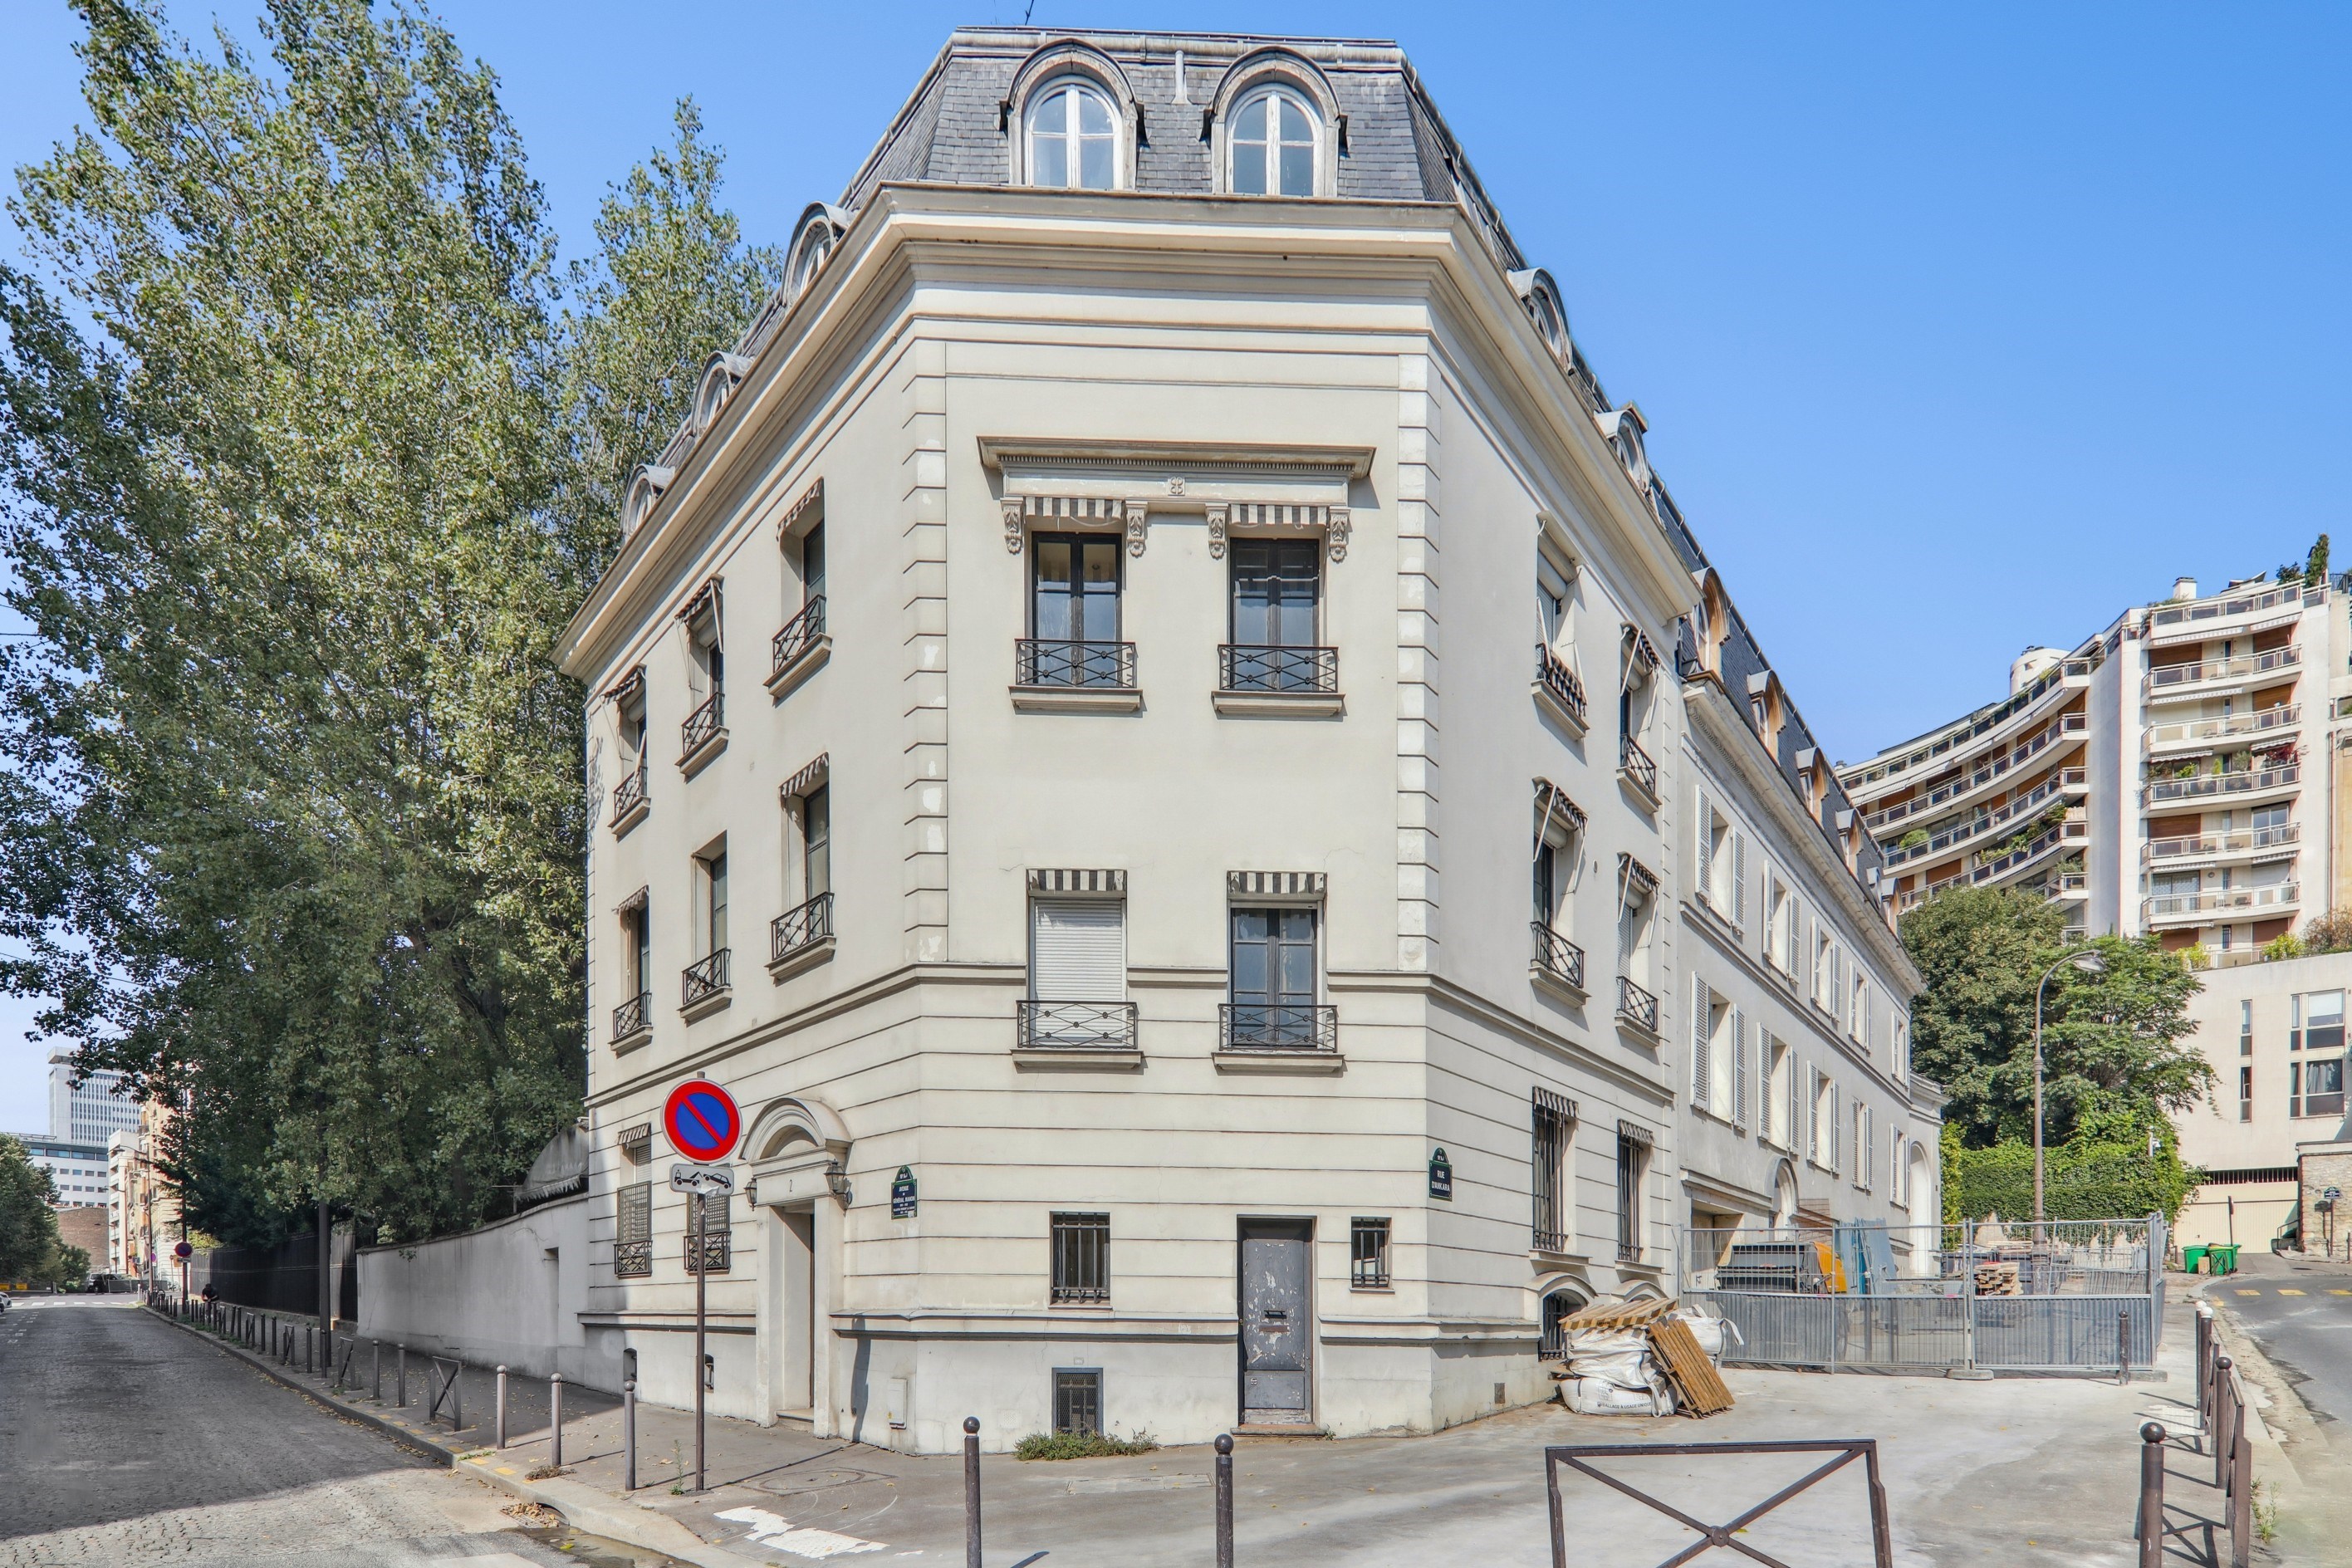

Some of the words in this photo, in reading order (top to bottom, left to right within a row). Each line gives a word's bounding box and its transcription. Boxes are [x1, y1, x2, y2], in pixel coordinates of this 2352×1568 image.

[1437, 1170, 1445, 1178] RUE
[789, 1179, 792, 1192] 2
[1431, 1181, 1450, 1191] D'ANKARA
